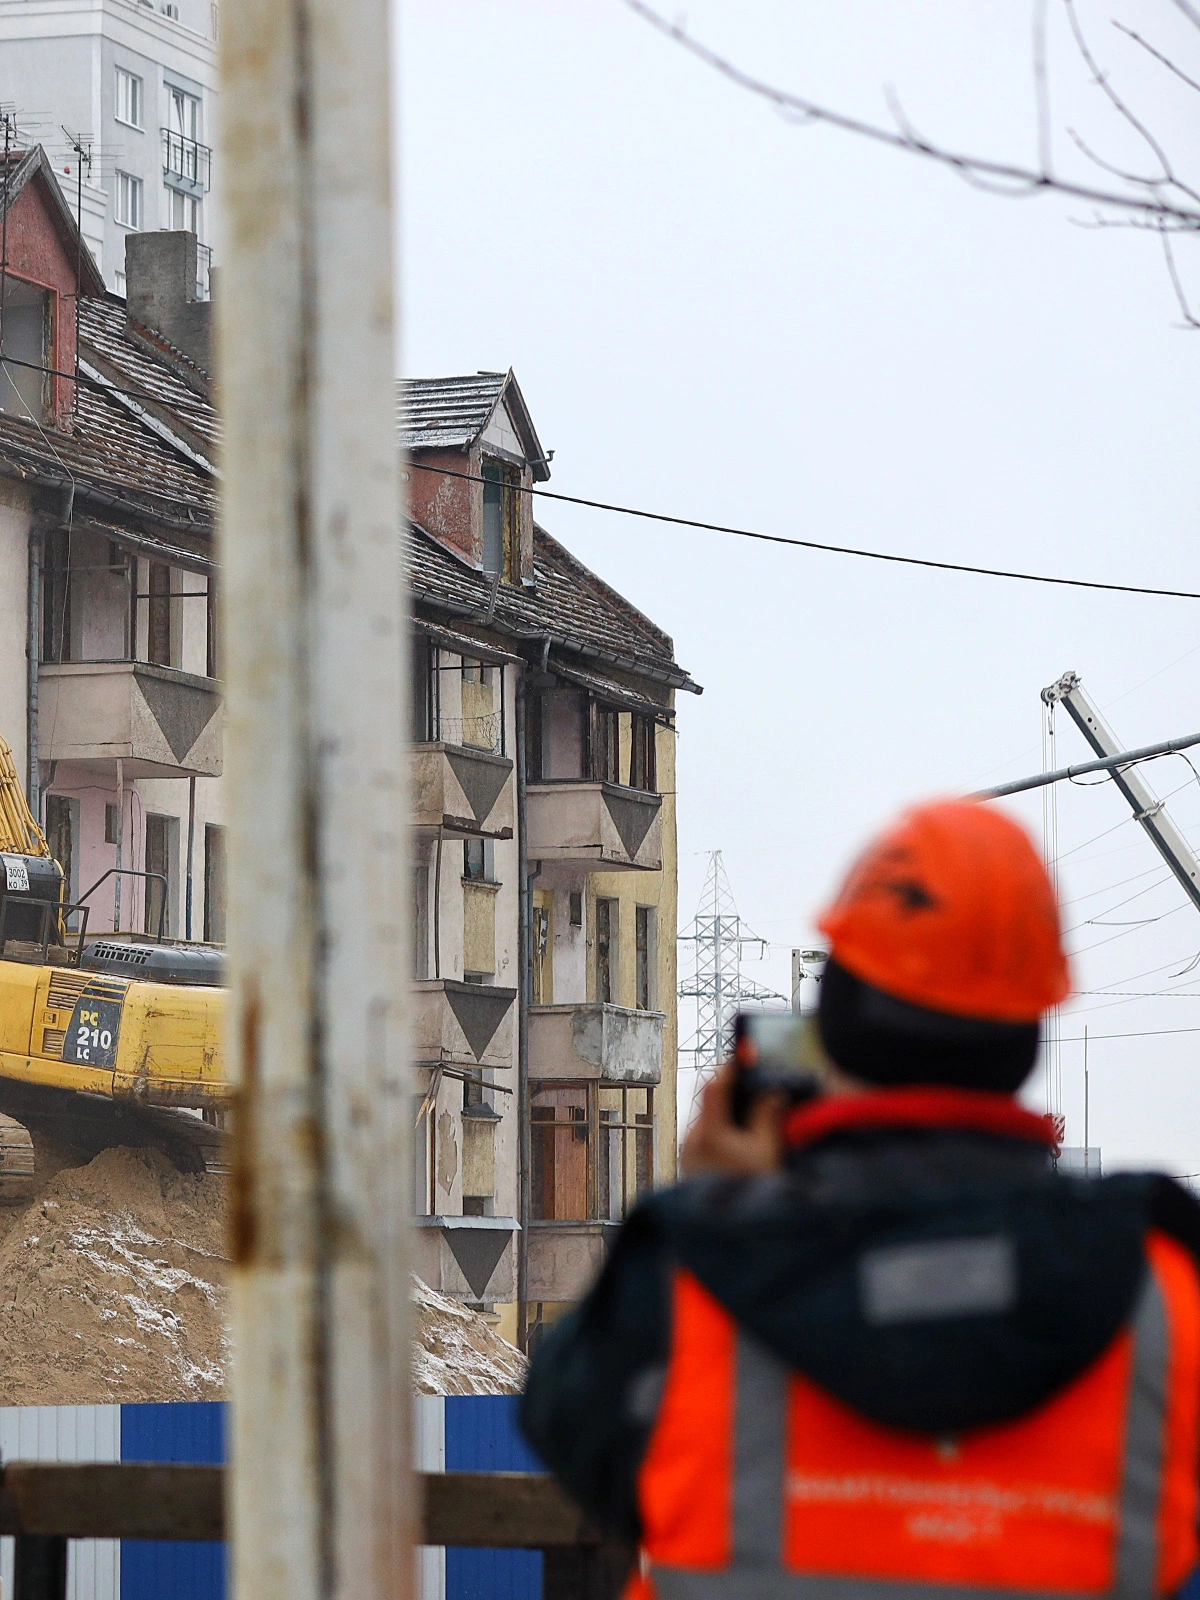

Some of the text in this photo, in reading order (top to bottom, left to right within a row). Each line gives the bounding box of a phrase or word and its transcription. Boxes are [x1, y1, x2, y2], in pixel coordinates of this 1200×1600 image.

[9, 868, 26, 879] 3002
[20, 879, 28, 887] 39
[80, 1010, 99, 1027] PC
[76, 1026, 112, 1050] 210
[76, 1047, 90, 1060] LC
